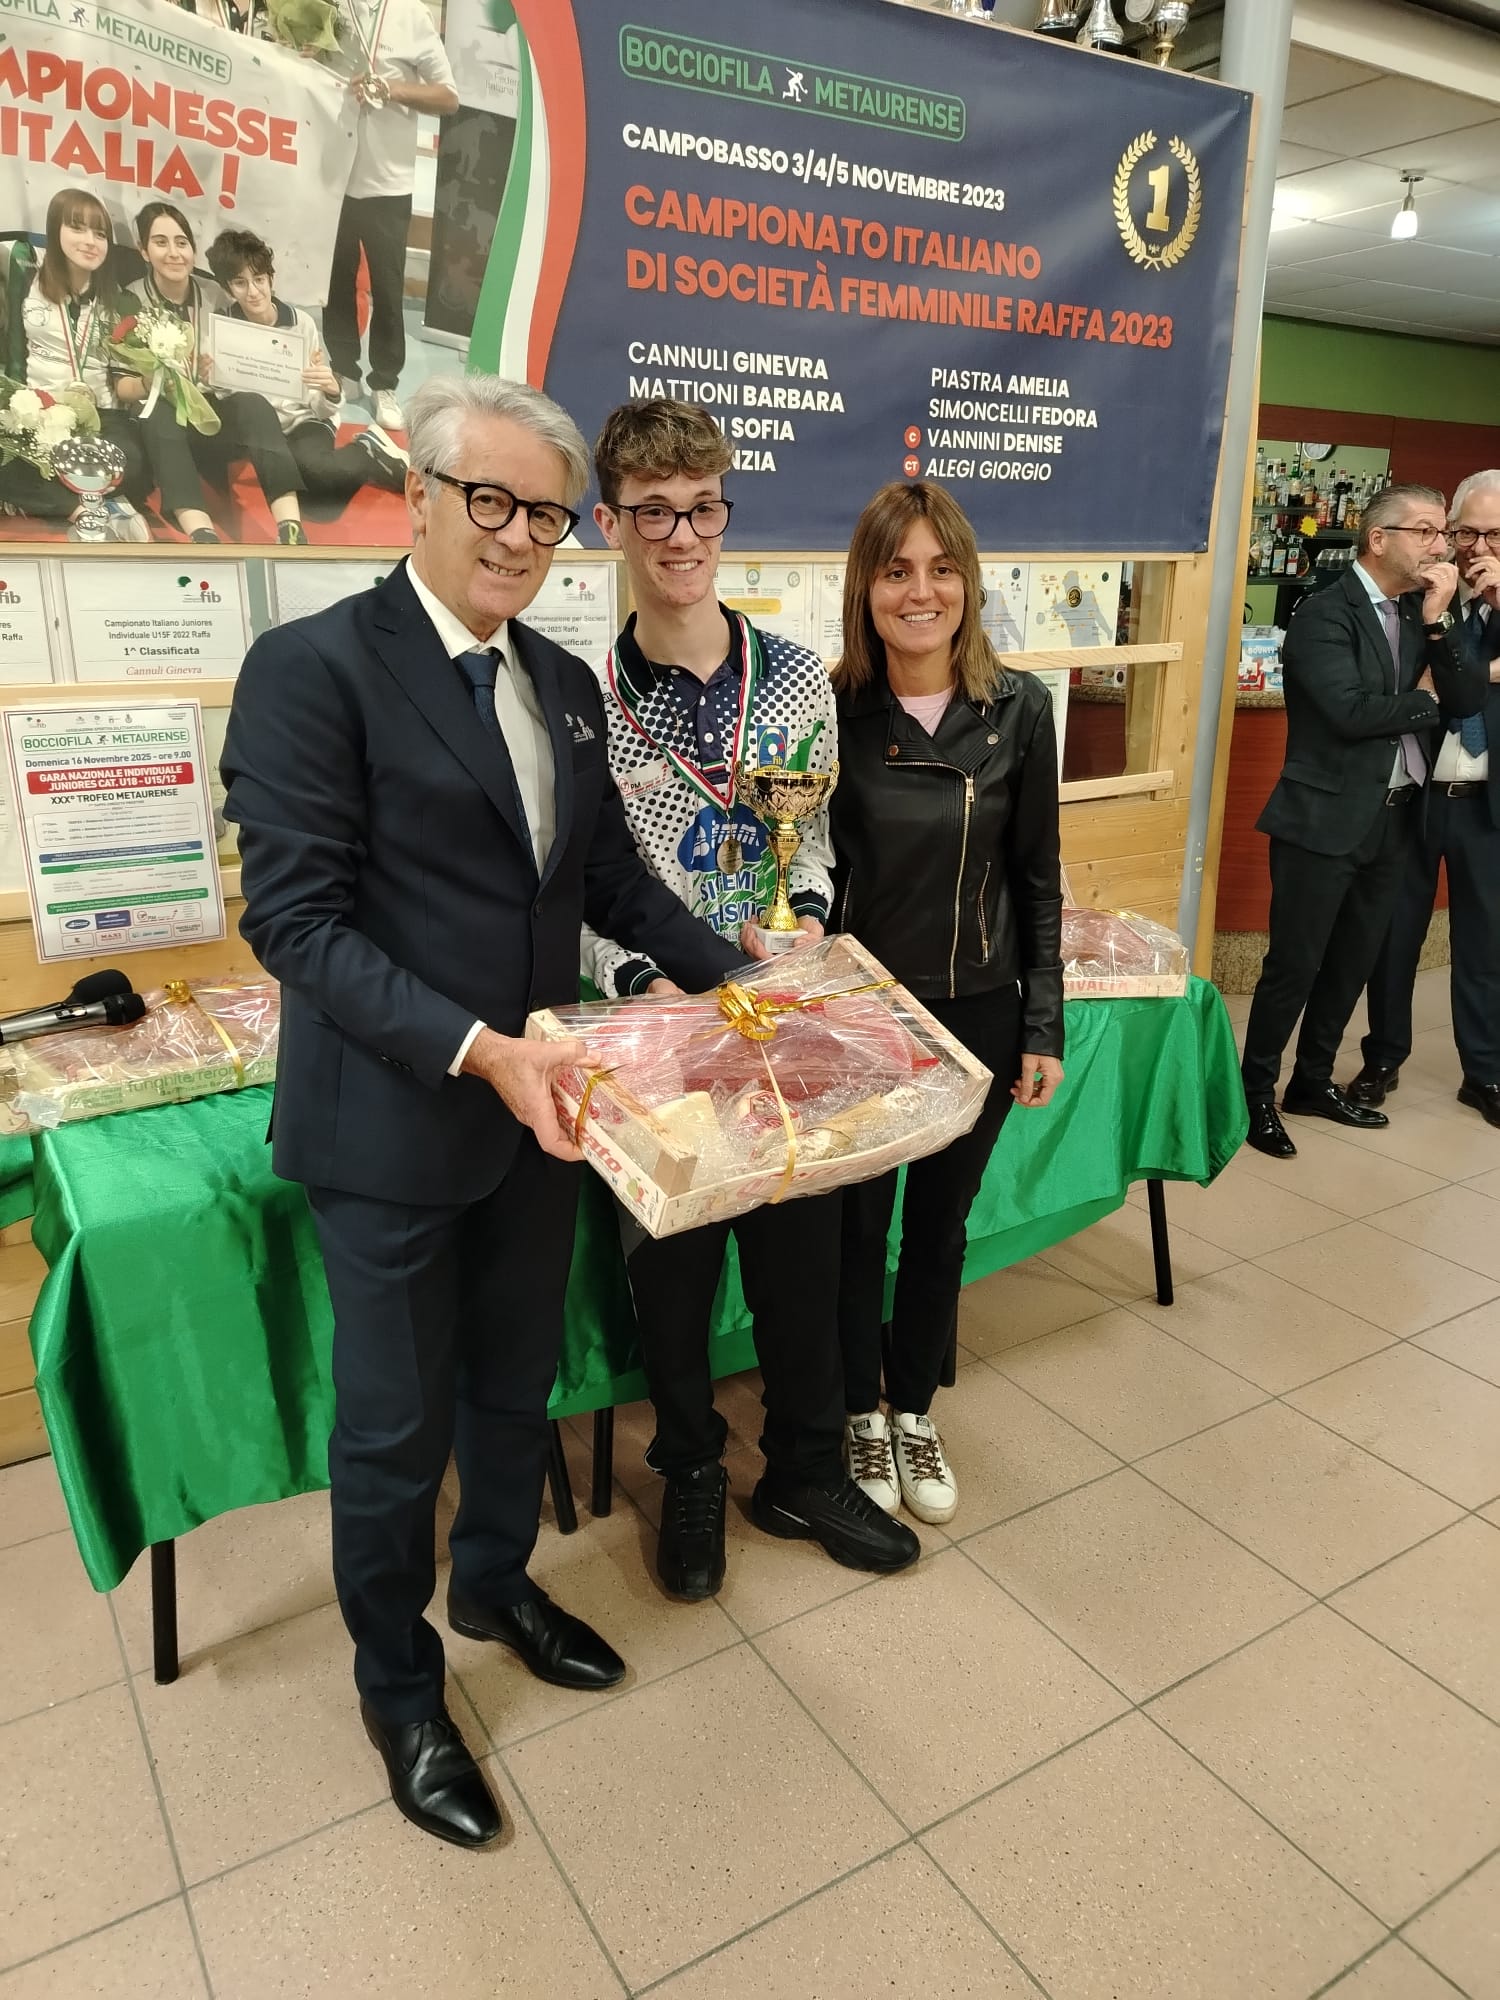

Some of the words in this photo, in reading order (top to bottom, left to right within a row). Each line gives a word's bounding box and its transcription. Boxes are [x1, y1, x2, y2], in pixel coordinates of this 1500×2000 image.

[96, 12, 227, 79] METAURENSE
[626, 36, 774, 95] BOCCIOFILA
[815, 77, 961, 133] METAURENSE
[1, 106, 204, 197] ITALIA
[622, 123, 789, 174] CAMPOBASSO
[792, 149, 849, 187] 3/4/5
[852, 164, 960, 203] NOVEMBRE
[962, 183, 1005, 211] 2023
[1146, 165, 1169, 232] 1
[624, 185, 888, 259] CAMPIONATO
[893, 226, 1041, 279] ITALIANO
[627, 248, 667, 292] DI
[674, 260, 835, 312] SOCIETÀ
[840, 278, 1012, 331] FEMMINILE
[1017, 298, 1106, 341] RAFFA
[1109, 310, 1173, 348] 2023
[628, 341, 728, 371] CANNULI
[733, 351, 829, 380] GINEVRA
[629, 376, 738, 405] MATTIONI
[743, 385, 845, 413] BARBARA
[931, 367, 1002, 393] PIASTRA
[1007, 375, 1070, 398] AMELIA
[929, 398, 1029, 424] SIMONCELLI
[1032, 406, 1098, 428] FEDORA
[731, 417, 795, 441] SOFIA
[908, 432, 917, 442] C
[927, 428, 1000, 451] VANNINI
[1003, 432, 1063, 454] DENISE
[904, 461, 919, 471] CT
[925, 458, 975, 479] ALEGI
[979, 461, 1051, 481] GIORGIO
[200, 591, 222, 603] fib
[104, 620, 150, 629] Campionato
[152, 619, 179, 627] Italiano
[182, 619, 213, 627] Juniores
[109, 631, 150, 639] Individuale
[152, 631, 171, 639] U15F
[173, 631, 190, 639] 2022
[192, 630, 211, 639] Raffa
[139, 646, 200, 656] Classificata
[126, 666, 163, 676] Cannuli
[166, 665, 202, 675] Ginevra
[24, 735, 92, 749] BOCCIOFILA
[112, 731, 187, 744] METAURENSE
[25, 759, 70, 768] Domenica
[72, 757, 82, 765] 16
[84, 755, 129, 765] Novembre
[174, 750, 191, 759] 9.00
[39, 773, 67, 782] GARA
[68, 768, 123, 780] NAZIONALE
[124, 765, 183, 777] INDIVIDUALE
[48, 781, 97, 792] JUNIORES
[98, 779, 118, 789] CAT.
[119, 777, 137, 786] U18
[144, 775, 177, 785] U15/12
[77, 793, 114, 803] TROFEO
[116, 788, 178, 801] METAURENSE
